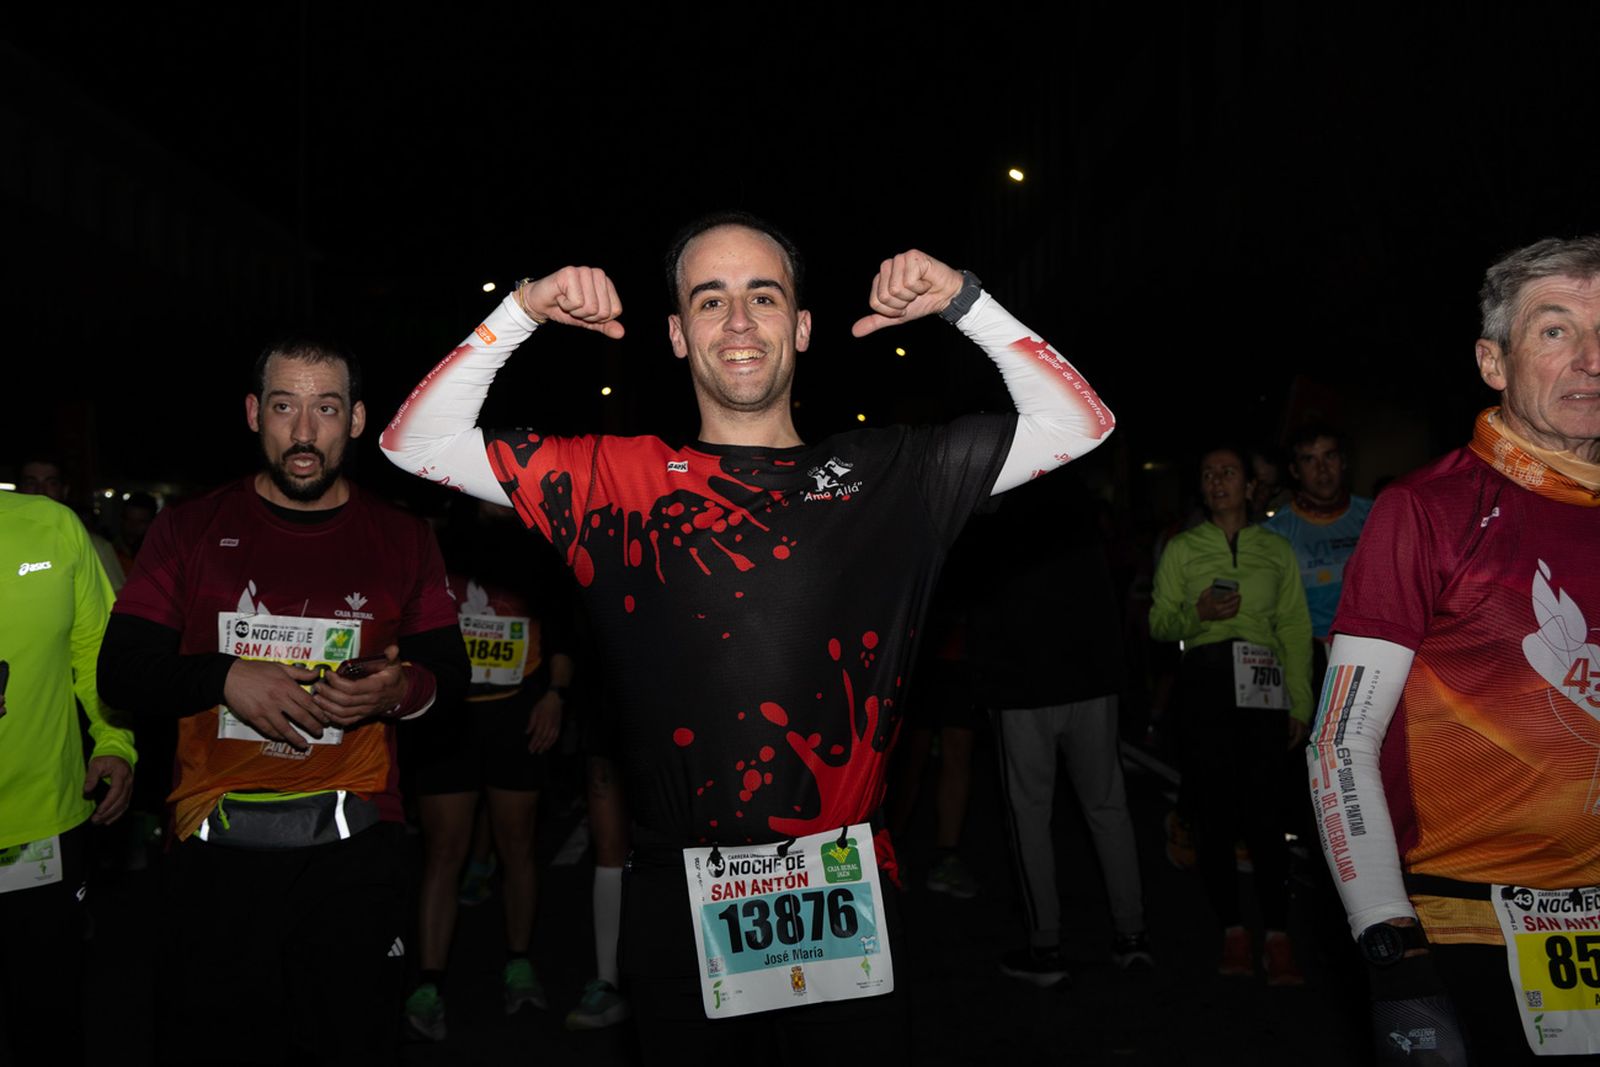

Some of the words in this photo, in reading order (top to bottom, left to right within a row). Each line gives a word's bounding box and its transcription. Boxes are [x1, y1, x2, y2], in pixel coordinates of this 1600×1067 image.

[410, 388, 421, 400] de
[1036, 349, 1064, 370] Aguilar
[1062, 371, 1073, 381] de
[1073, 382, 1081, 390] la
[1080, 390, 1107, 426] Frontera
[235, 623, 249, 633] 43
[251, 628, 294, 642] NOCHE
[297, 631, 313, 643] DE
[234, 642, 262, 656] SAN
[469, 640, 514, 661] 1845
[1251, 666, 1281, 686] 7570
[1336, 766, 1356, 793] SUBIDA
[1321, 791, 1338, 809] DEL
[1342, 792, 1358, 804] AL
[1344, 803, 1366, 837] PANTANO
[1324, 809, 1358, 883] QUIEBRAJANO
[729, 859, 781, 877] NOCHE
[785, 855, 805, 871] DE
[711, 879, 747, 901] SAN
[750, 871, 809, 896] ANTÓN
[1513, 893, 1533, 907] 43
[718, 888, 859, 954] 13876
[1523, 915, 1562, 932] SAN
[1564, 915, 1600, 930] ANT
[764, 950, 790, 966] José
[792, 945, 824, 960] María
[1545, 934, 1600, 990] 85
